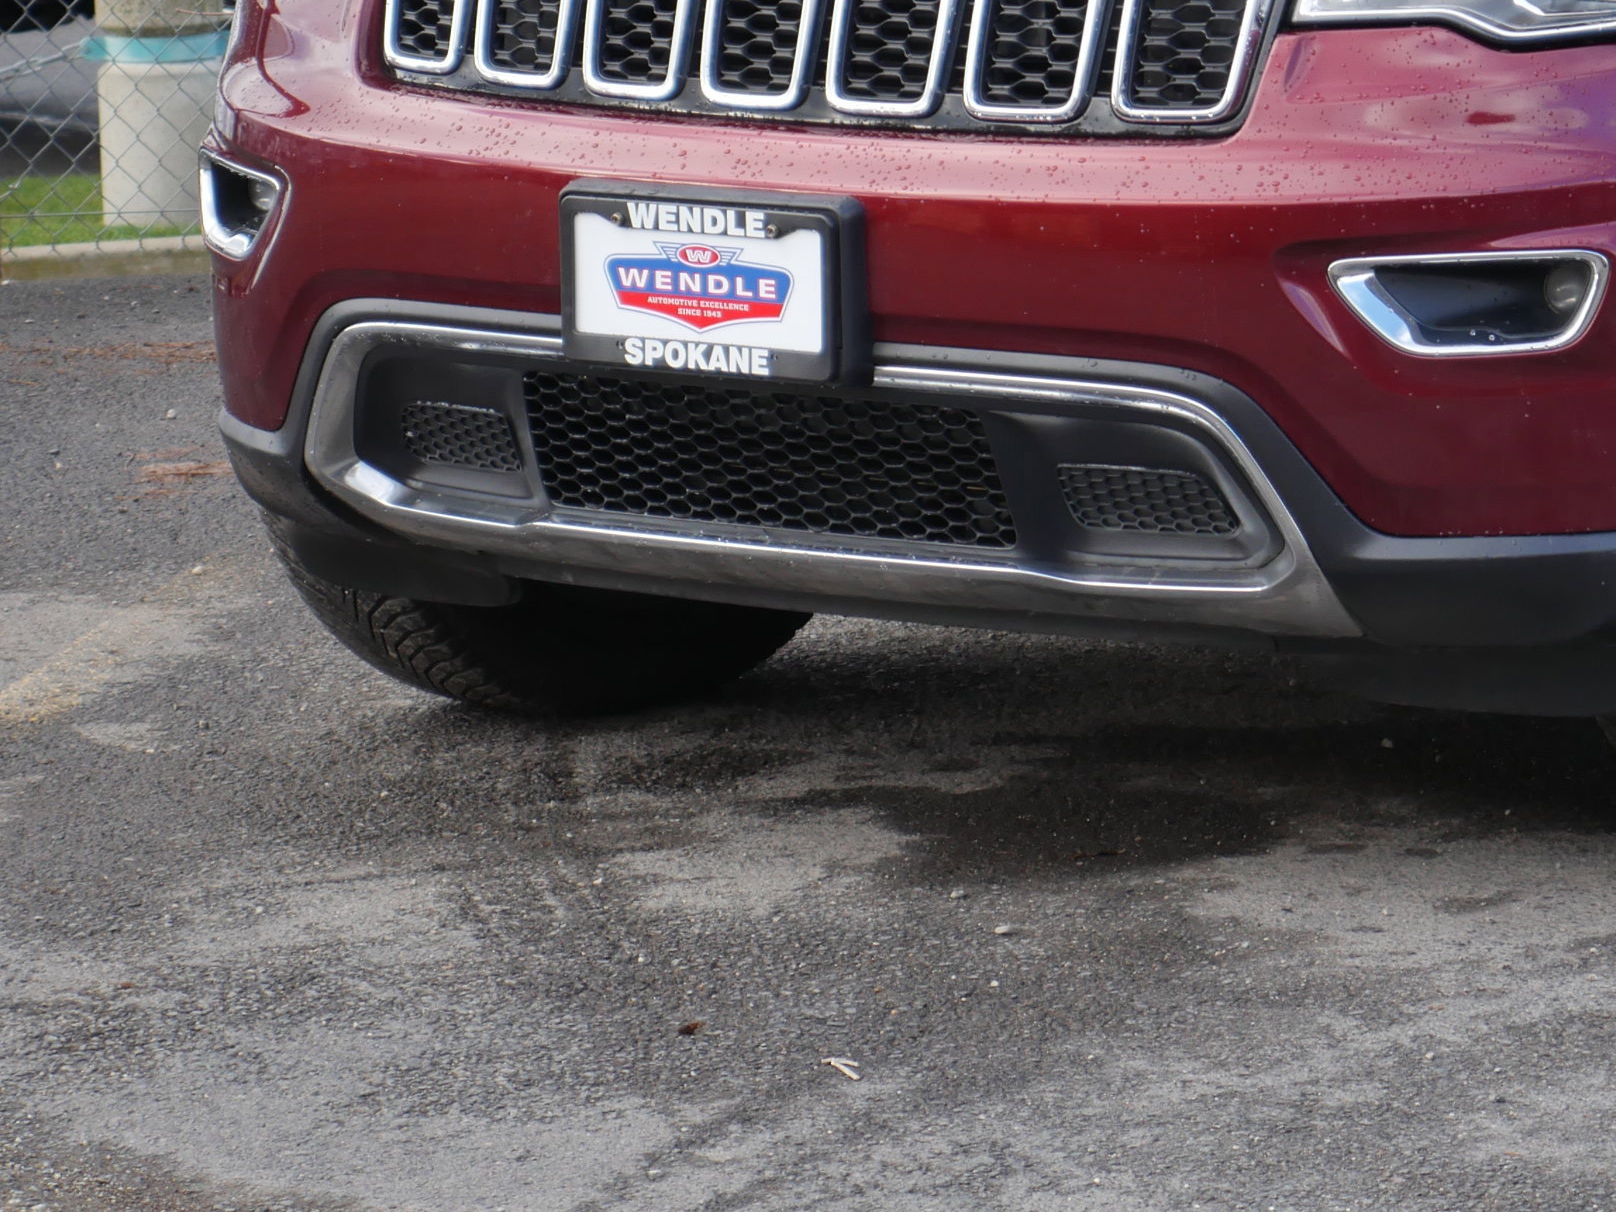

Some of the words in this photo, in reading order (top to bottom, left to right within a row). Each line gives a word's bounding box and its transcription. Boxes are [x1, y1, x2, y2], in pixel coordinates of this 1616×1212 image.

[627, 202, 766, 238] WENDLE
[618, 267, 777, 299] WENDLE
[647, 296, 698, 307] AUTOMOTIVE
[699, 299, 750, 312] EXCELLENCE
[677, 308, 701, 316] SINCE
[624, 338, 770, 376] SPOKANE
